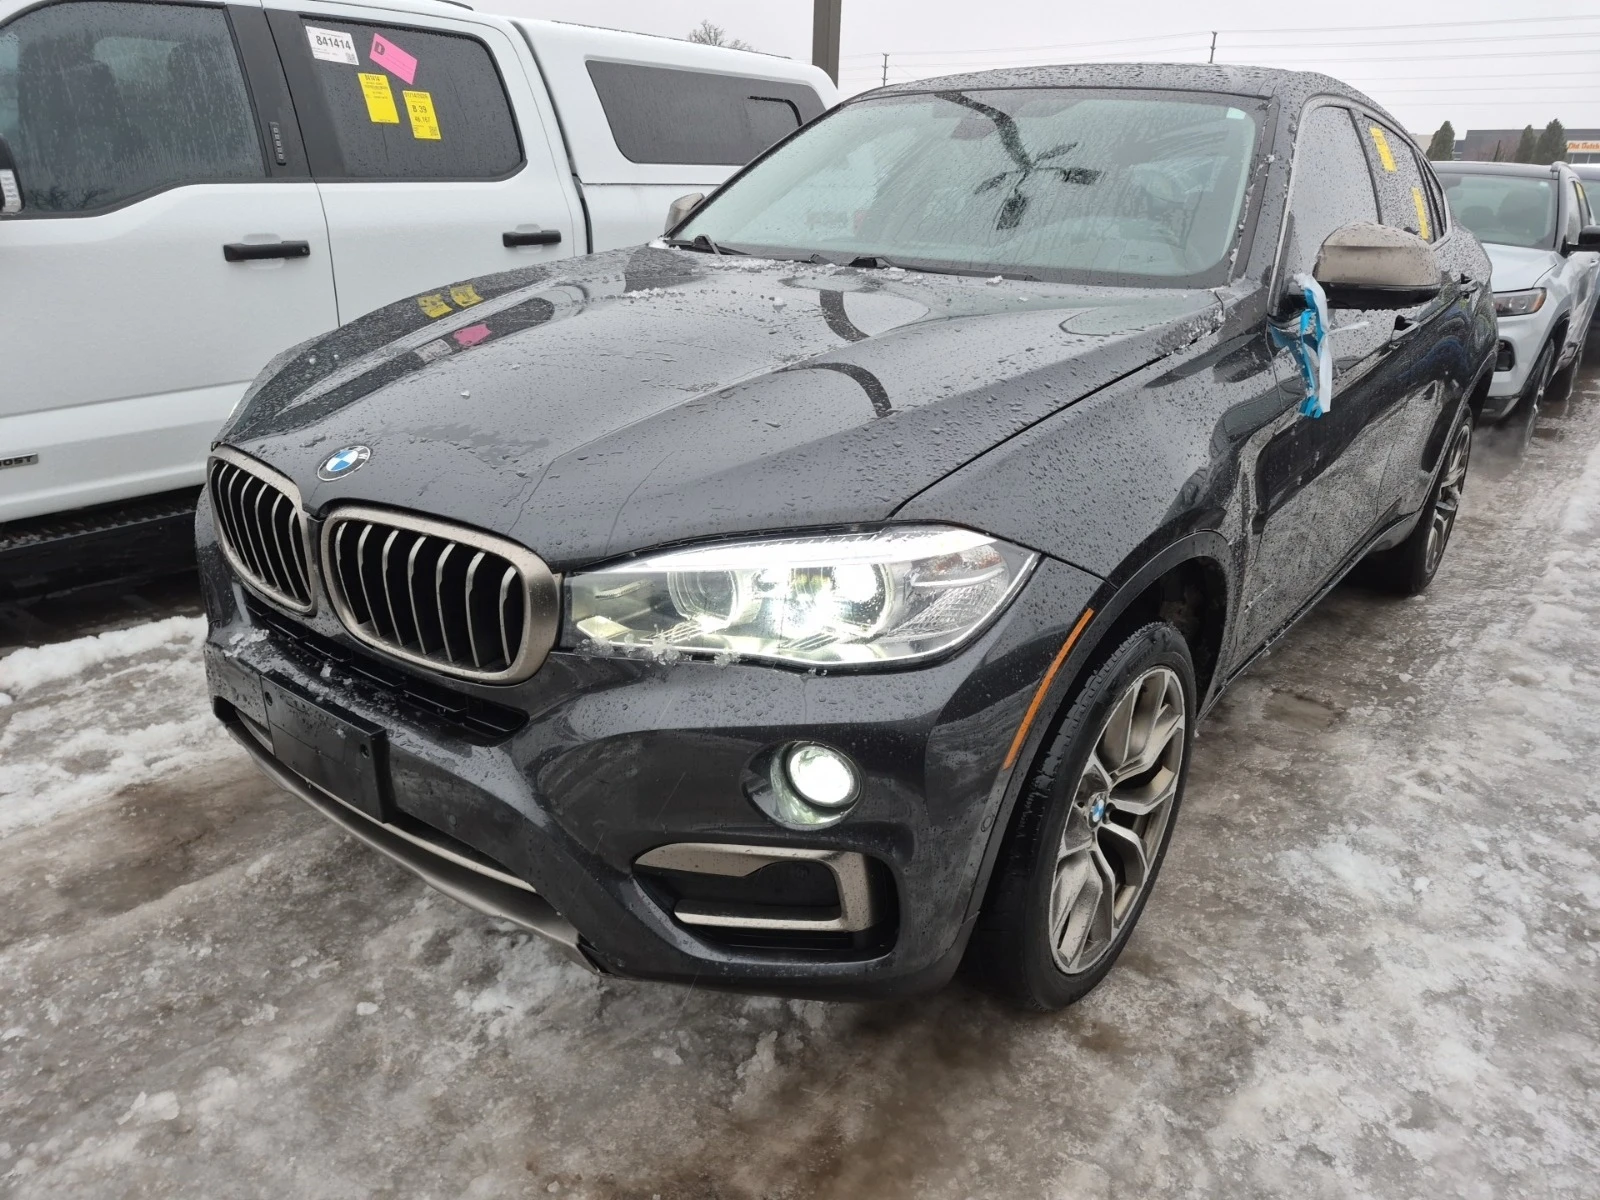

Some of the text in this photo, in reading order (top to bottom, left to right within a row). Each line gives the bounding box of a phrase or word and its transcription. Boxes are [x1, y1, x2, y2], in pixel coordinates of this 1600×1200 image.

[316, 35, 351, 50] 841414
[374, 41, 385, 55] D
[418, 105, 428, 113] 39
[0, 455, 33, 466] OST
